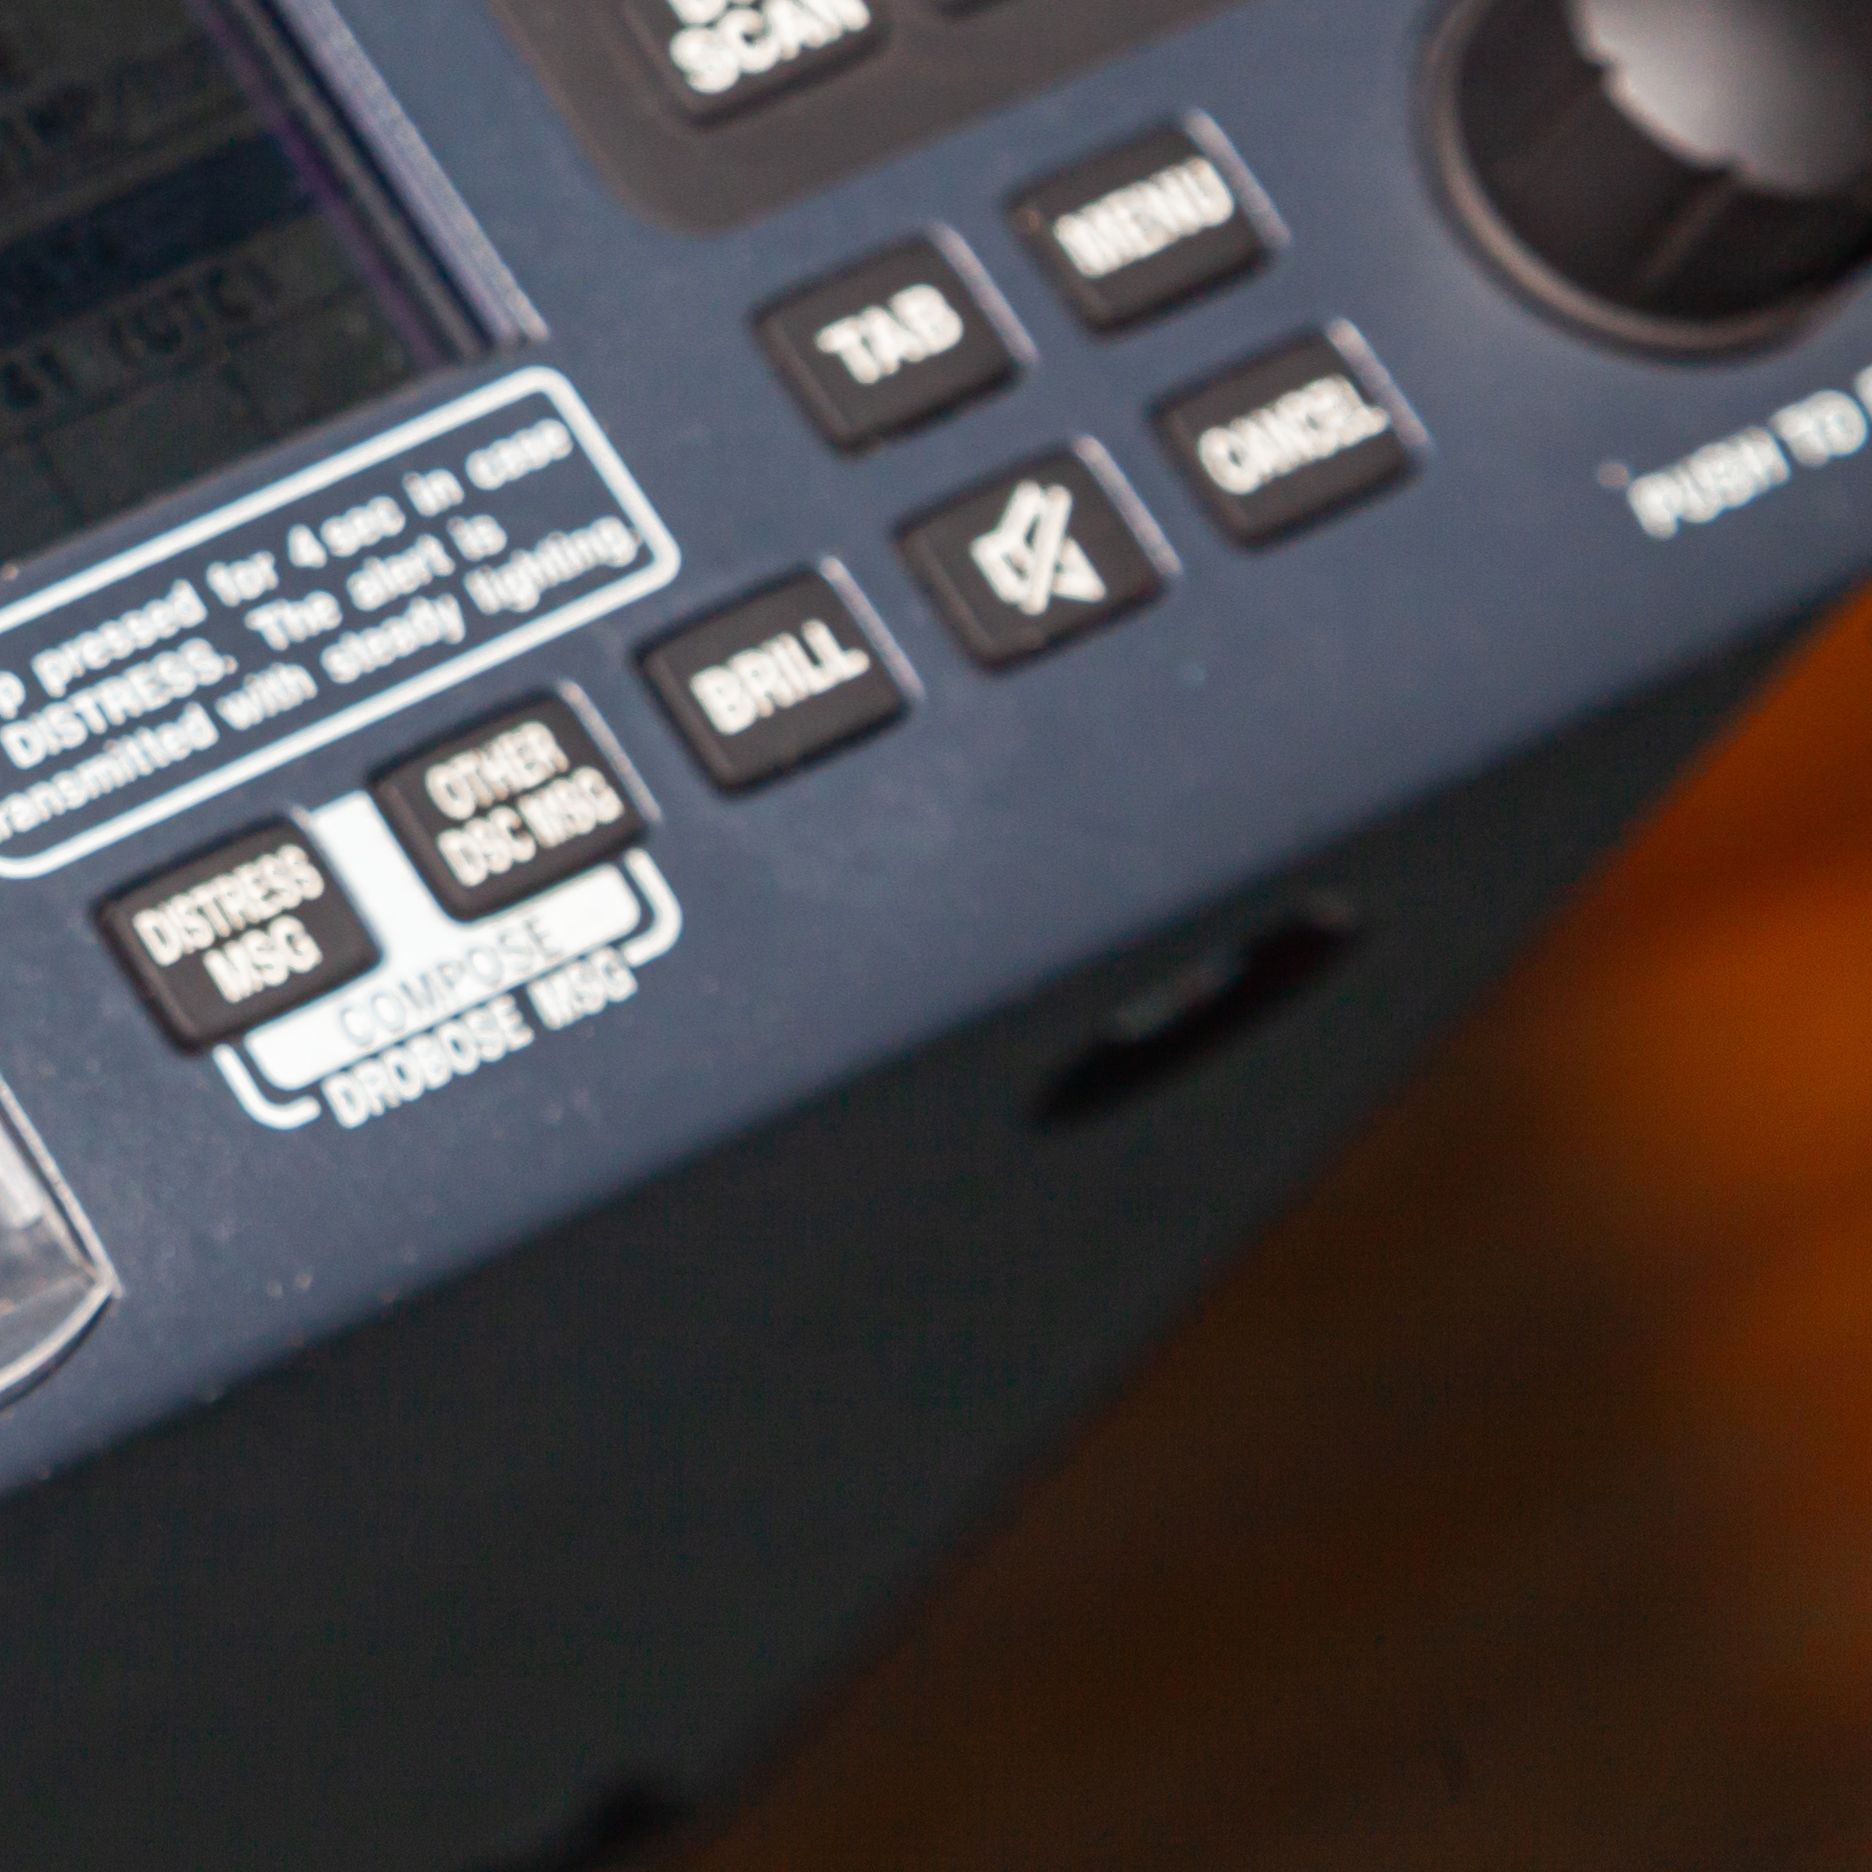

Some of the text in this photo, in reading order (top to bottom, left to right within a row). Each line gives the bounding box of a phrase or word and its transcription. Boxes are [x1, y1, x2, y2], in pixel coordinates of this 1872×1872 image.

[1054, 156, 1234, 278] MENU
[814, 283, 964, 384] TAB
[1197, 373, 1390, 495] CANCEL
[31, 578, 207, 697] pressed
[206, 551, 279, 607] for
[288, 524, 326, 568] 4
[320, 496, 405, 557] sec
[402, 469, 464, 517] in
[465, 418, 573, 490] case
[0, 637, 238, 769] DISTRESS.
[244, 590, 342, 651] The
[346, 534, 455, 611] alert
[446, 514, 507, 561] is
[216, 663, 318, 729] with
[320, 594, 465, 684] steady
[690, 619, 870, 734] BRILL
[425, 722, 570, 819] OTHER
[438, 767, 623, 886] DSC MSG
[133, 844, 324, 966] DISTRESS
[202, 916, 322, 1003] MSG
[339, 915, 562, 1044] COMPOSE
[528, 946, 638, 1030] MSG
